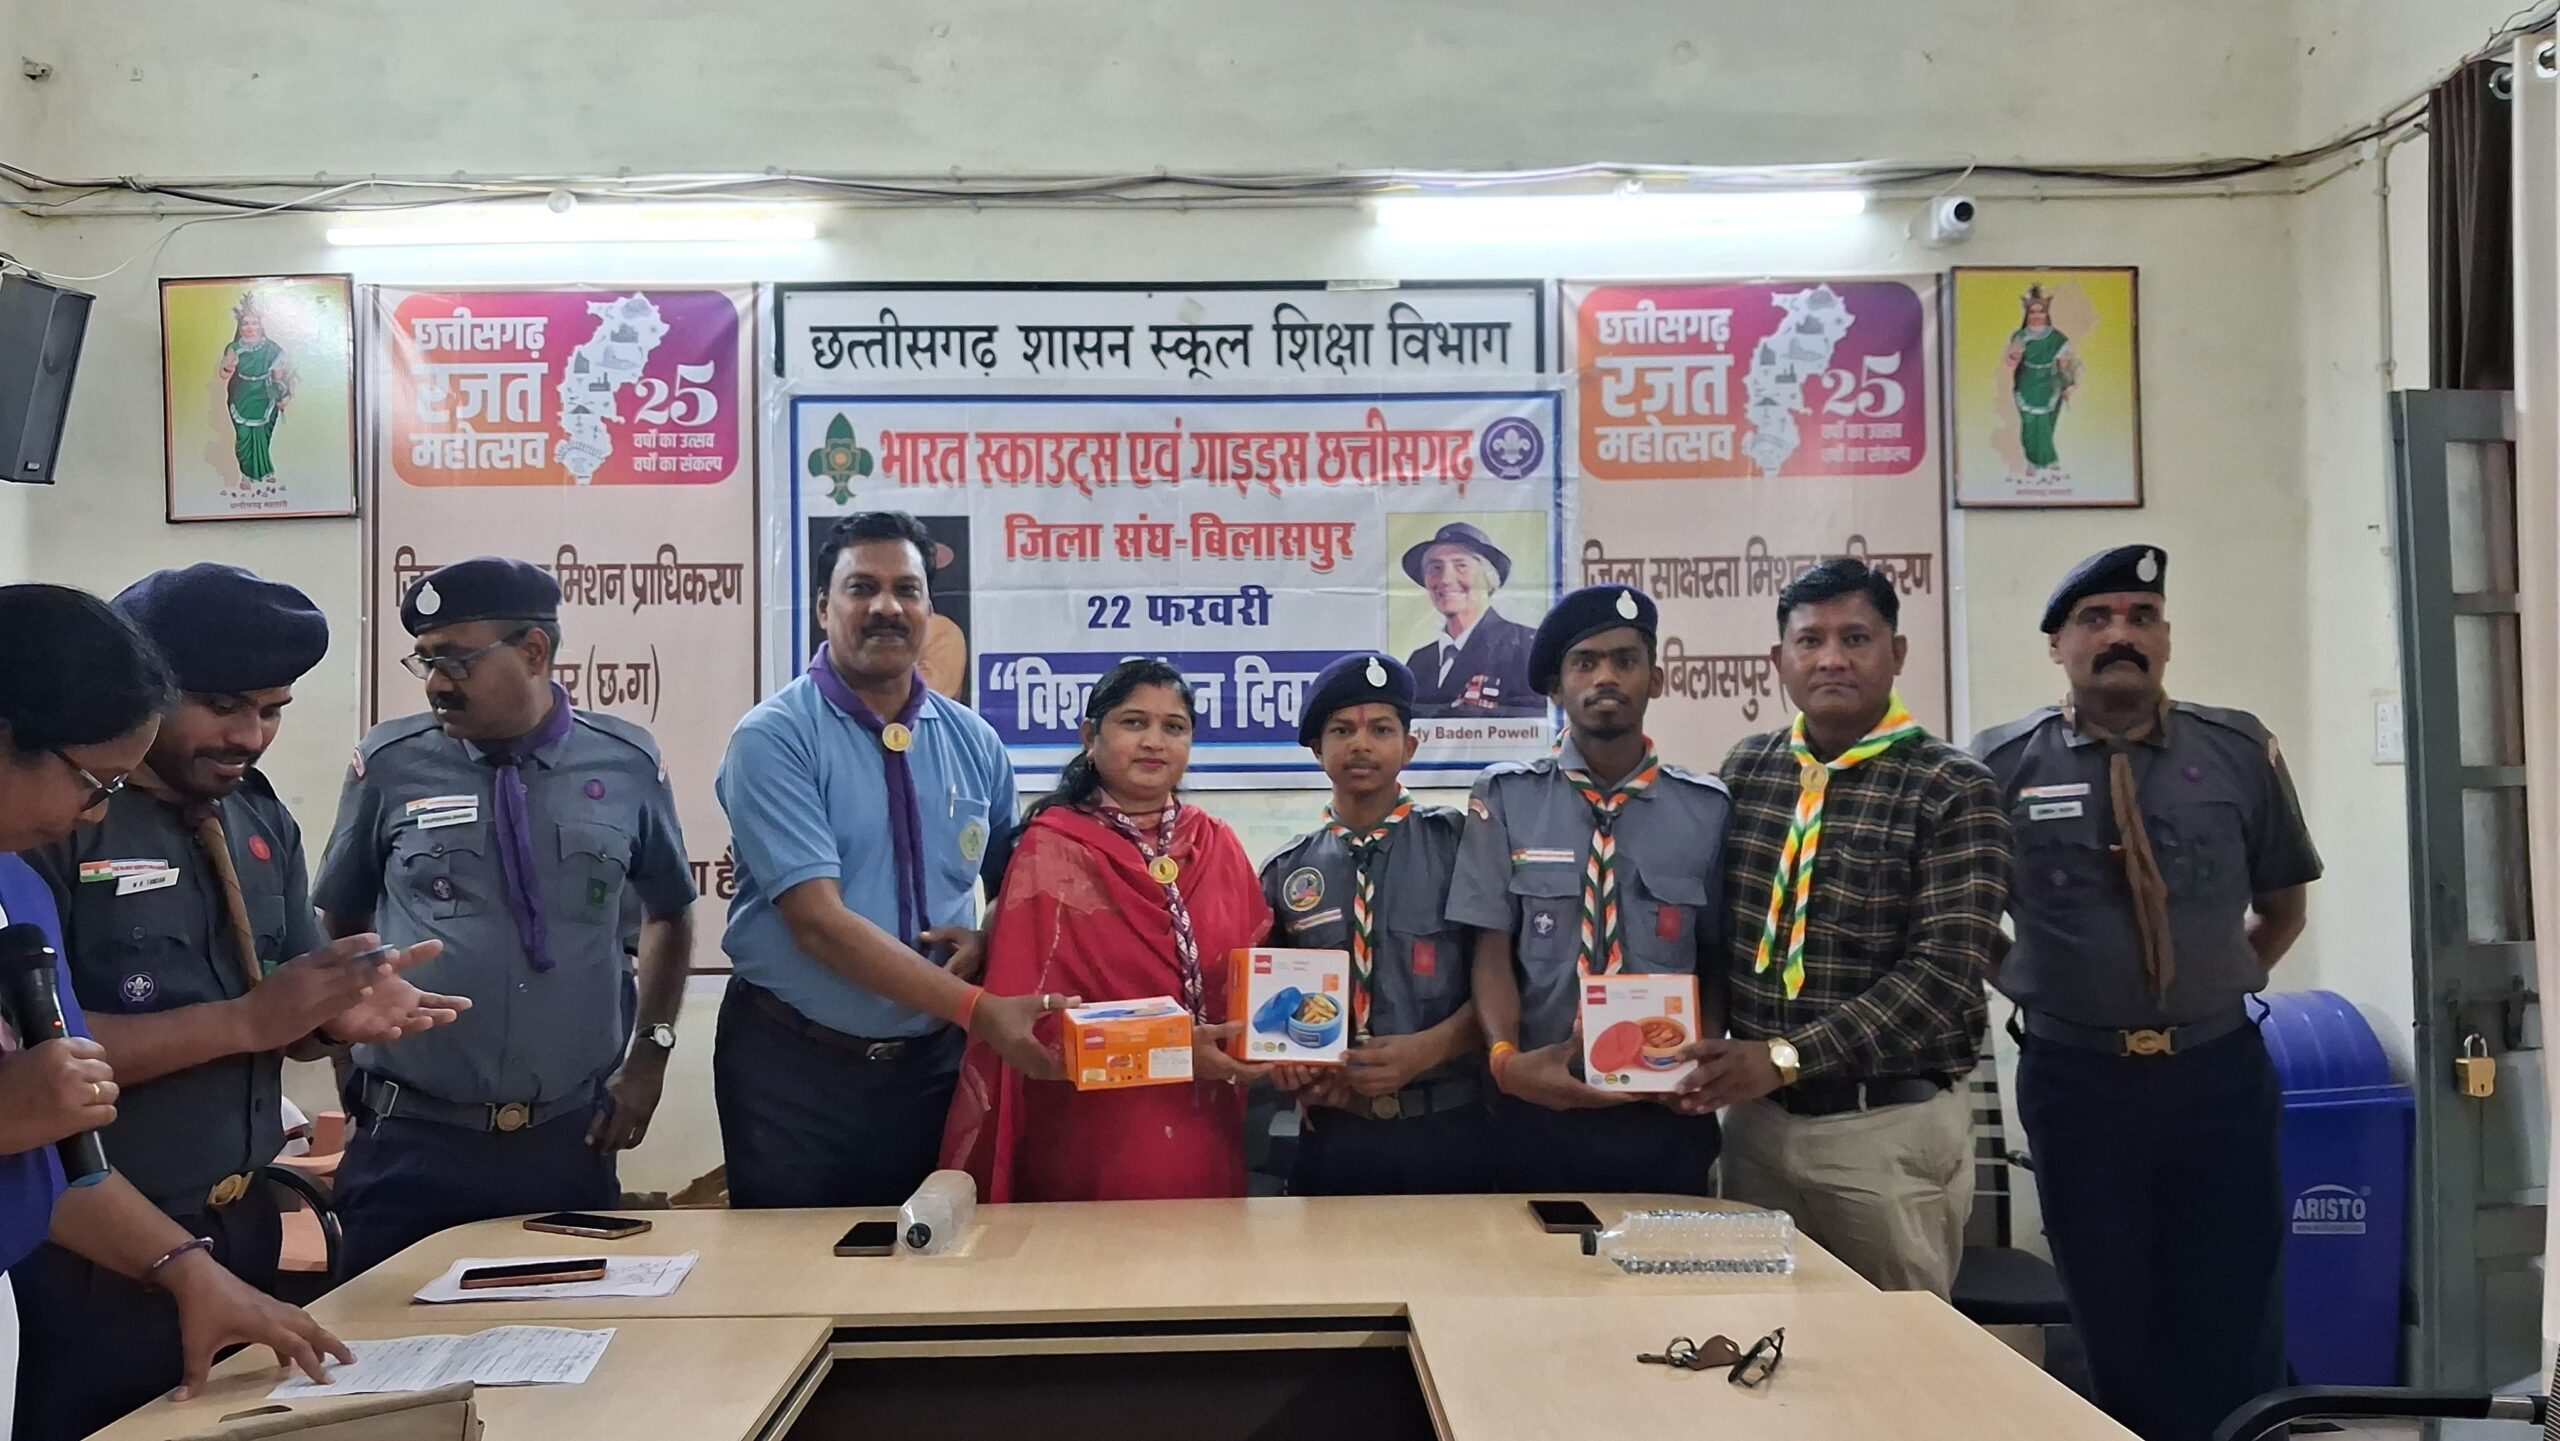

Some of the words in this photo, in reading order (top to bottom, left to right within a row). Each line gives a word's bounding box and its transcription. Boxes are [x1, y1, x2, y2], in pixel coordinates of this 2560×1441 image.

[810, 307, 998, 376] छत्तीसगढ़
[1017, 325, 1134, 374] शासन
[1149, 324, 1253, 378] स्कूल
[1272, 302, 1374, 375] शिक्षा
[1388, 302, 1511, 366] विभाग
[411, 362, 548, 425] रजत
[634, 360, 718, 427] 25
[1596, 354, 1735, 418] रजत
[1821, 352, 1905, 418] 25
[409, 421, 549, 469] महोत्सव
[659, 433, 677, 448] का
[659, 456, 677, 472] का
[880, 429, 969, 488] भारत
[975, 432, 1121, 499] स्काउट्स
[1126, 417, 1183, 486] एवं
[1190, 432, 1309, 499] गाइड्स
[1595, 416, 1736, 464] महोत्सव
[1005, 512, 1103, 562] जिला
[630, 544, 744, 614] प्राधिकरण
[1650, 556, 1740, 600] साक्षरता
[1088, 595, 1131, 629] 22
[1146, 585, 1273, 627] फरवरी
[1435, 726, 1482, 740] Baden
[1488, 726, 1539, 740] Powell
[2292, 1198, 2366, 1220] ARISTO
